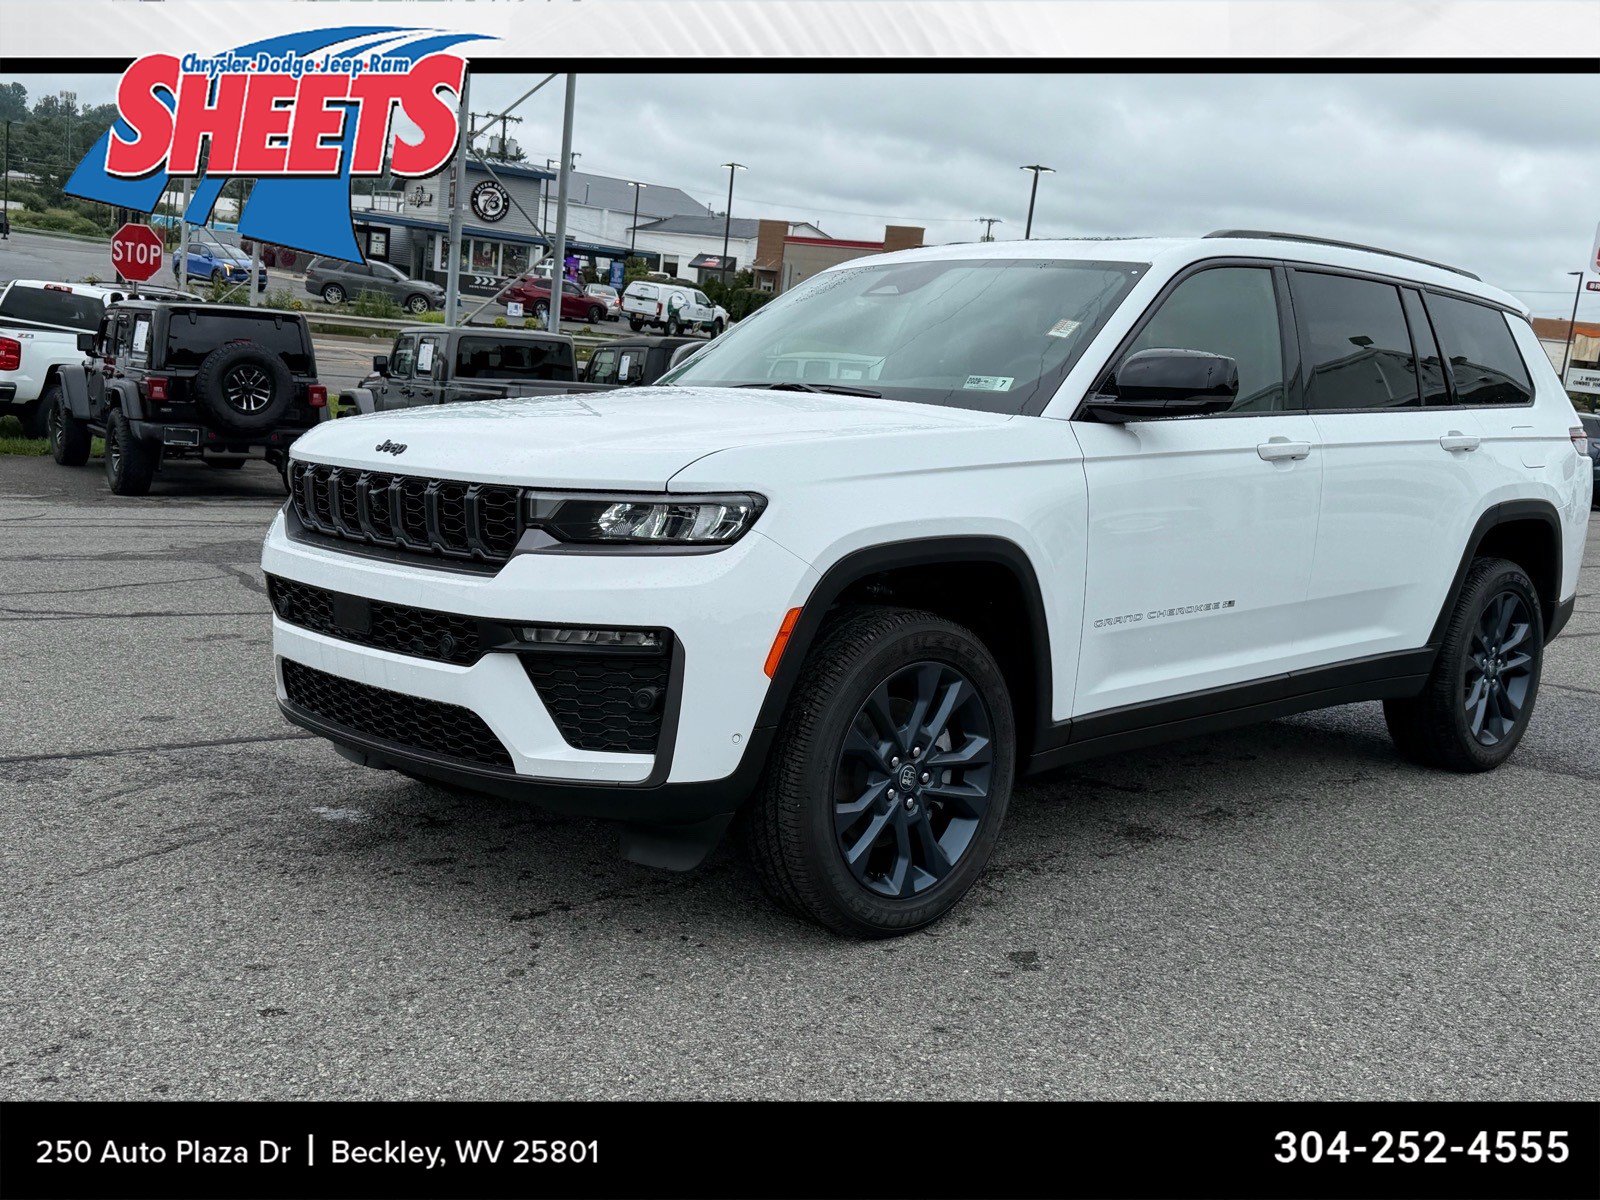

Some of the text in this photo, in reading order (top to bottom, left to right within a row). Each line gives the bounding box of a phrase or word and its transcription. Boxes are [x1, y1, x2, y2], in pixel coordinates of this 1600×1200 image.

[113, 240, 161, 266] STOP
[375, 439, 408, 457] Jeep
[1093, 613, 1144, 628] GRAND
[1146, 601, 1221, 620] CHEROKEE
